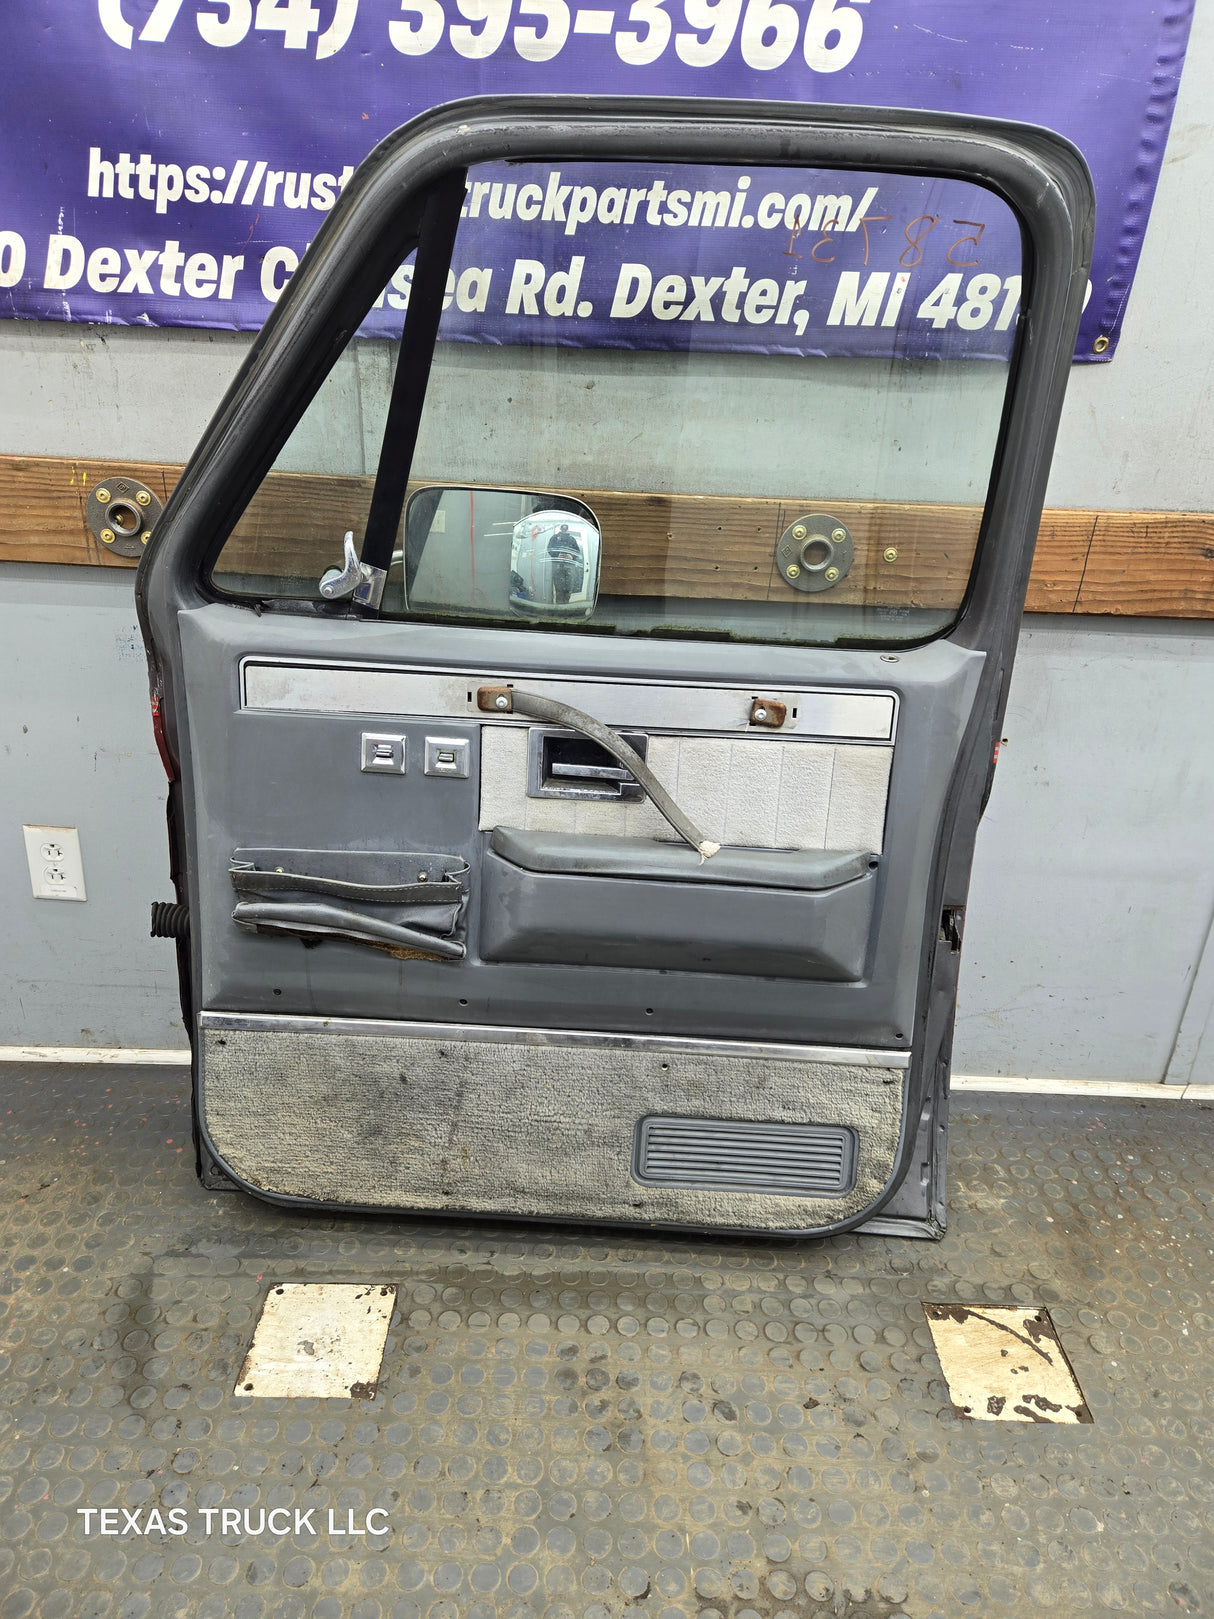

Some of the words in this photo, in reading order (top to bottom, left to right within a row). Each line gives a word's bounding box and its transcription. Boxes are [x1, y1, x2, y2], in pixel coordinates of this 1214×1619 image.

[97, 0, 359, 60] (734)
[388, 0, 864, 73] 395-3966
[43, 233, 245, 300] Dexter
[504, 255, 593, 317] Rd.
[609, 262, 809, 336] Dexter,
[825, 271, 911, 327] MI
[917, 272, 1093, 331] 481
